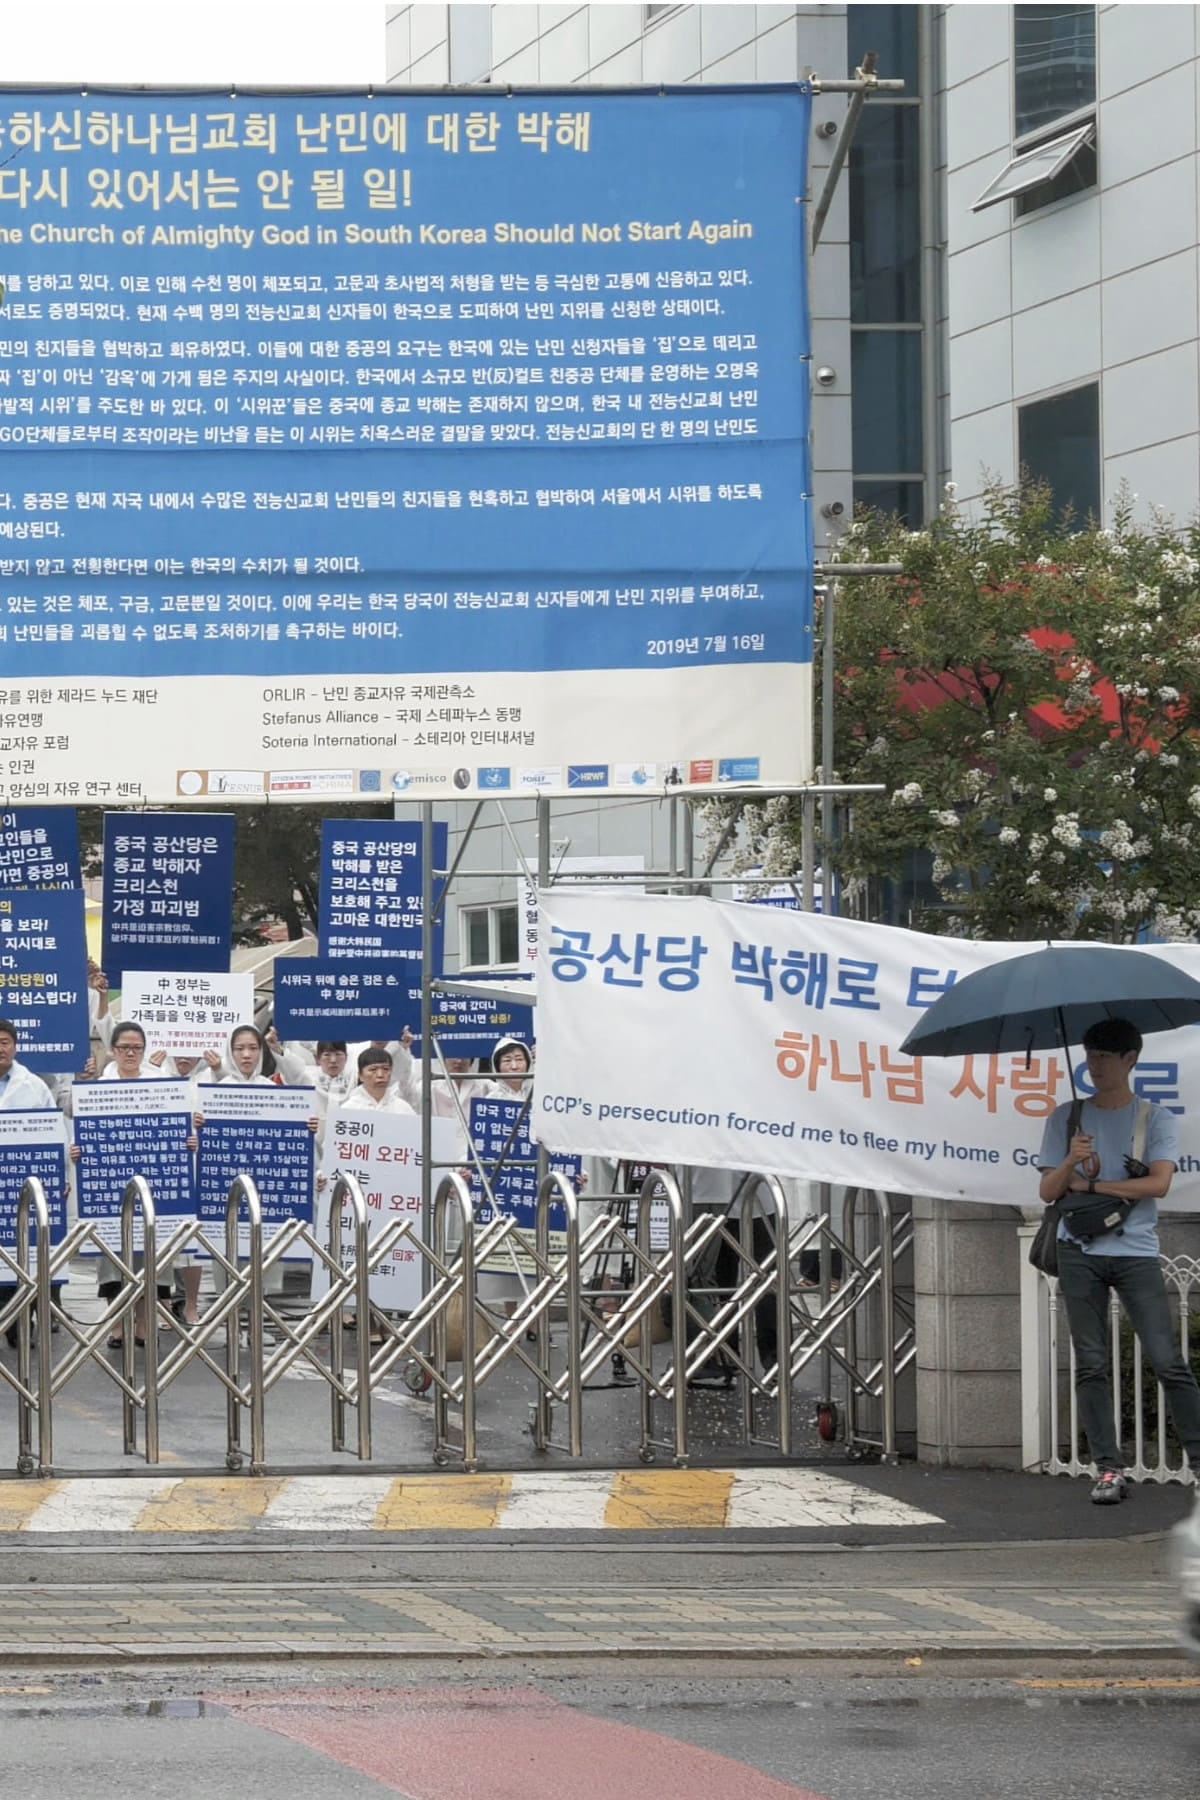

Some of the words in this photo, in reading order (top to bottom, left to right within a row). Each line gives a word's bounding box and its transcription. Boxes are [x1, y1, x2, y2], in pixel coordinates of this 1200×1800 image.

[296, 111, 406, 153] 난민에
[427, 111, 500, 153] 대한
[518, 111, 590, 152] 박해
[88, 168, 239, 211] 있어서는
[257, 169, 293, 210] 안
[311, 169, 345, 210] 될
[364, 168, 411, 210] 일!
[30, 224, 114, 244] Church
[122, 225, 145, 245] of
[151, 224, 255, 248] Almighty
[262, 225, 310, 245] God
[317, 225, 338, 244] in
[345, 224, 412, 244] South
[420, 224, 487, 244] Korea
[494, 223, 574, 243] Should
[582, 223, 621, 243] Not
[628, 222, 682, 241] Start
[687, 219, 752, 244] Again
[14, 624, 74, 641] 난민들을
[80, 624, 126, 641] 괴롭힐
[132, 625, 147, 641] 수
[153, 624, 198, 641] 없도록
[204, 623, 280, 640] 조처하기를
[285, 622, 346, 640] 촉구하는
[353, 622, 402, 639] 바이다.
[647, 637, 699, 655] 2019년
[704, 636, 726, 652] 7월
[733, 634, 764, 650] 16일
[27, 689, 52, 704] 위한
[57, 689, 96, 703] 제라드
[101, 689, 127, 703] 누드
[132, 689, 158, 704] 재단
[263, 712, 321, 725] Stefanus
[326, 710, 378, 723] Alliance
[396, 709, 421, 723] 국제
[426, 708, 491, 722] 스테파누스
[496, 708, 521, 722] 동맹
[114, 836, 147, 853] 중국
[152, 837, 218, 853] 공산당은
[332, 841, 358, 856] 중국
[363, 841, 416, 857] 공산당의
[113, 857, 146, 874] 종교
[152, 858, 201, 875] 박해자
[332, 859, 372, 874] 박해를
[376, 859, 403, 874] 받은
[112, 879, 178, 895] 크리스천
[330, 877, 398, 892] 크리스천을
[112, 900, 144, 916] 가정
[150, 900, 199, 917] 파괴범
[330, 895, 371, 909] 보호해
[375, 896, 402, 909] 주고
[17, 919, 48, 932] 보라!
[329, 913, 370, 927] 고마운
[5, 937, 57, 950] 지시대로
[549, 925, 708, 992] 공산당
[731, 941, 880, 1010] 박해로
[175, 979, 211, 991] 정부는
[8, 992, 77, 1006] 의심스럽다!
[140, 994, 188, 1007] 크리스천
[192, 994, 228, 1007] 박해에
[131, 1010, 179, 1023] 가족들을
[211, 1011, 240, 1023] 말라!
[775, 1030, 924, 1104] 하나님
[335, 1120, 374, 1137] 중공이
[542, 1095, 593, 1116] CCP's
[598, 1101, 720, 1128] persecution
[727, 1113, 795, 1138] forced
[800, 1125, 833, 1143] me
[839, 1128, 859, 1147] to
[863, 1131, 899, 1152] flee
[905, 1140, 936, 1160] my
[943, 1140, 1000, 1164] home
